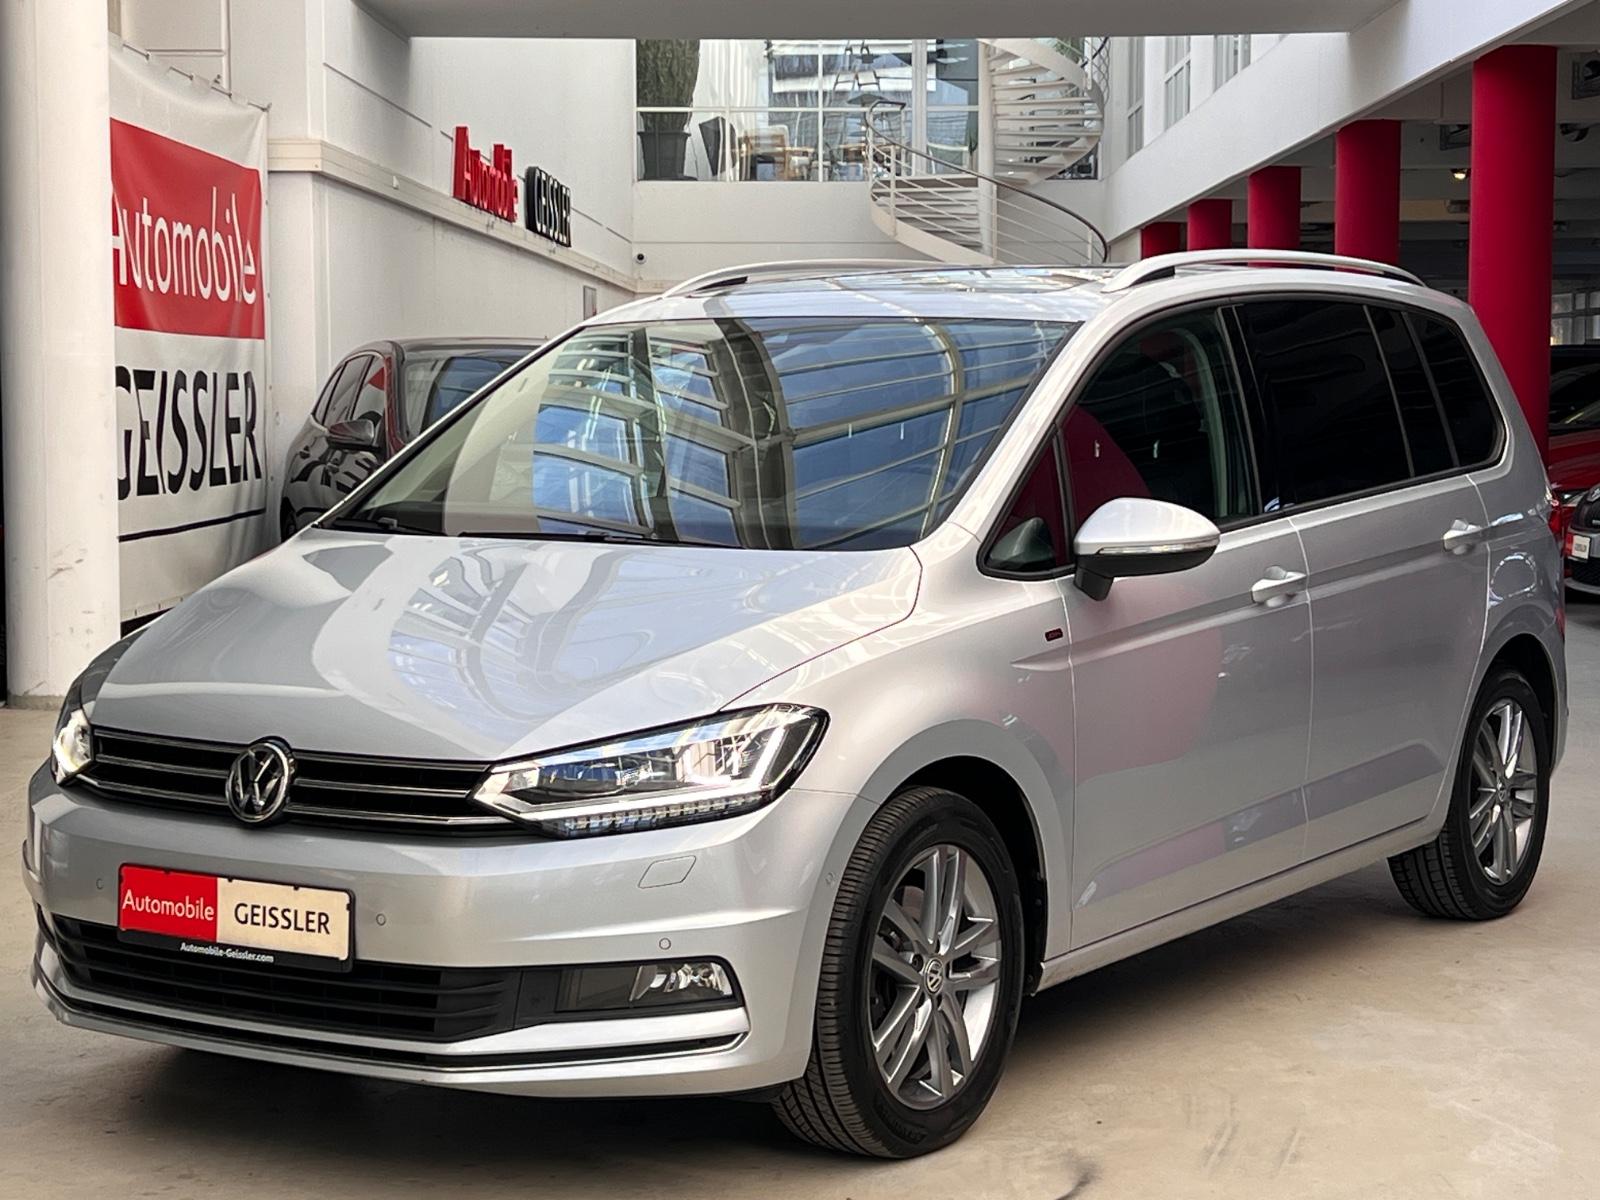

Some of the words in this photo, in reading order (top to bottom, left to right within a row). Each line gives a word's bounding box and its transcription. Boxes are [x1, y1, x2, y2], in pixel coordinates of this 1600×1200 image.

[453, 126, 518, 223] Automobe
[525, 166, 571, 247] GEISSLER
[122, 889, 215, 921] Automobile
[234, 903, 330, 934] GEISSLER
[180, 942, 274, 963] Automobile-Geissler.com
